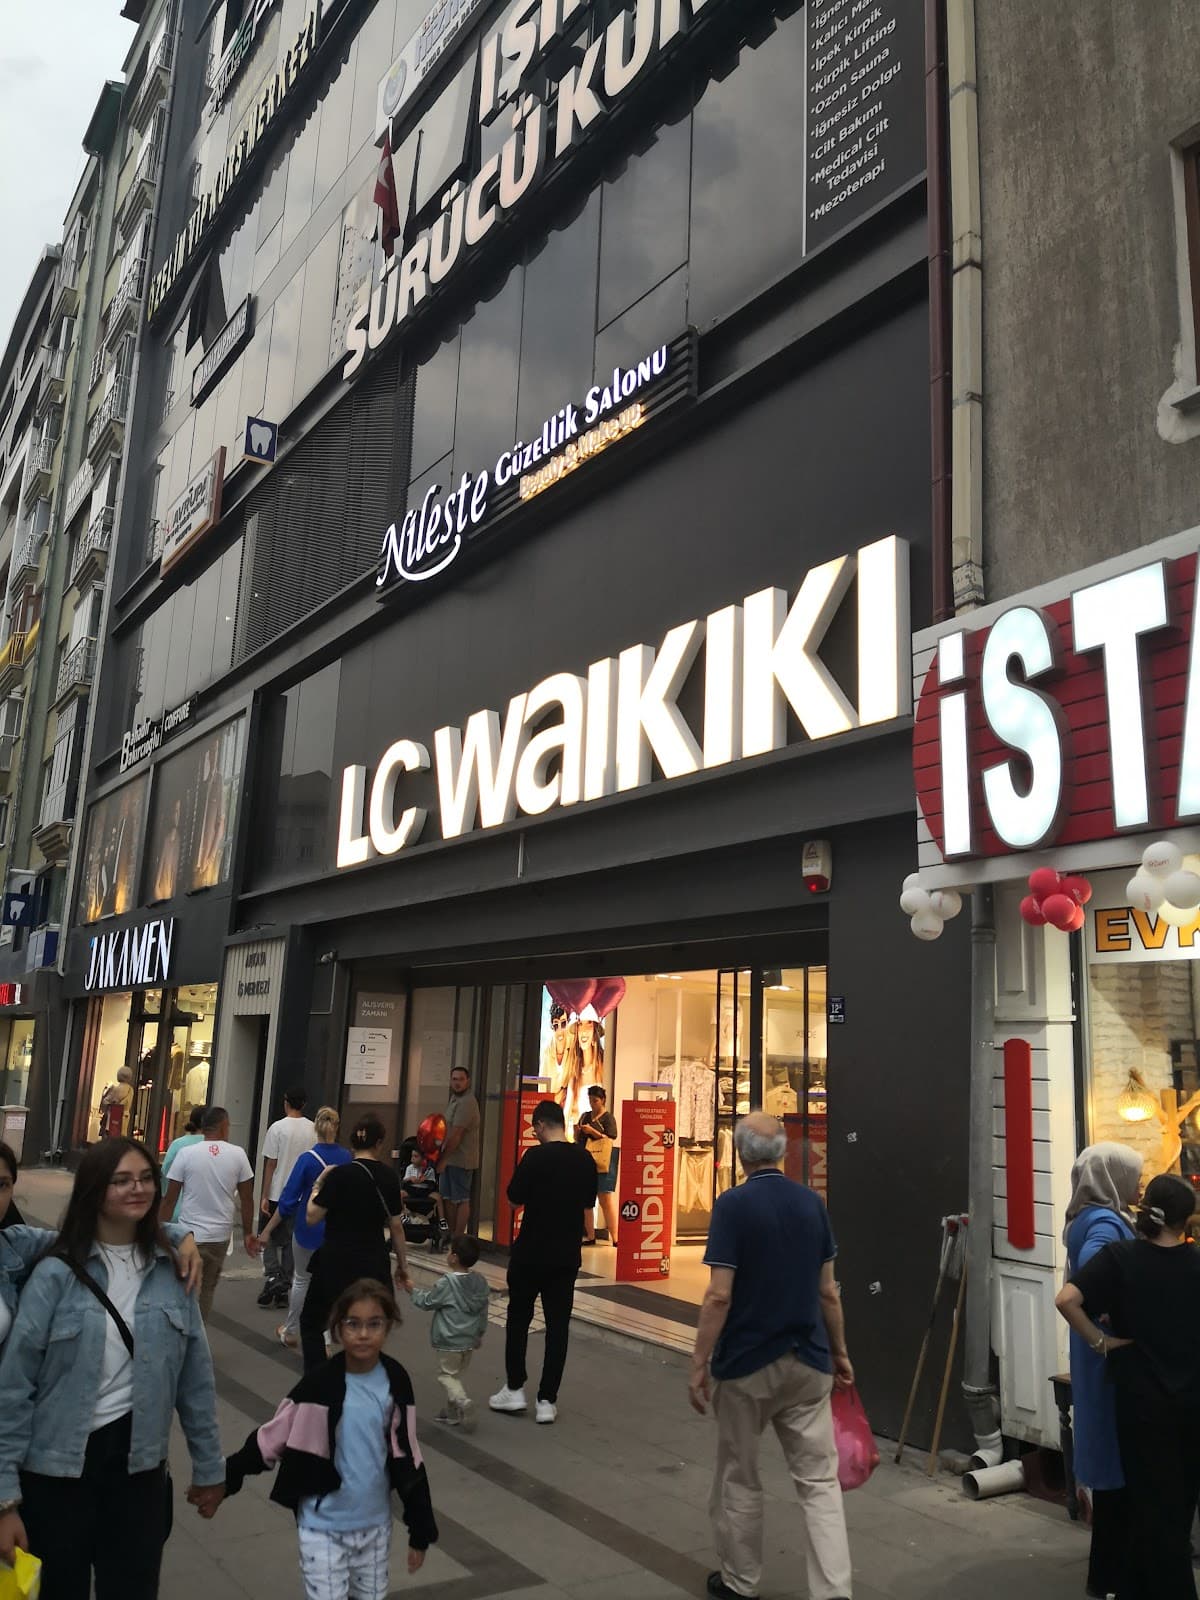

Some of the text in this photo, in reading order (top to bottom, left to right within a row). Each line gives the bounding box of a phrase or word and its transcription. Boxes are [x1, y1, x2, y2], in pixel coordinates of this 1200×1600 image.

[815, 18, 896, 93] Kirpik Lifting
[844, 7, 882, 46] Kirpik
[815, 47, 890, 114] Ozon Sauna
[861, 61, 901, 100] Dolgu
[814, 100, 882, 160] Cilt Bakımı
[815, 118, 889, 184] Medical Cilt
[814, 157, 886, 220] Mezoterapi
[826, 142, 878, 190] Tedavisi
[343, 92, 547, 381] SÜRÜCÜ
[337, 739, 431, 868] LC
[84, 917, 174, 991] JAKAMEN
[662, 1132, 675, 1145] 30
[621, 1203, 640, 1218] 40
